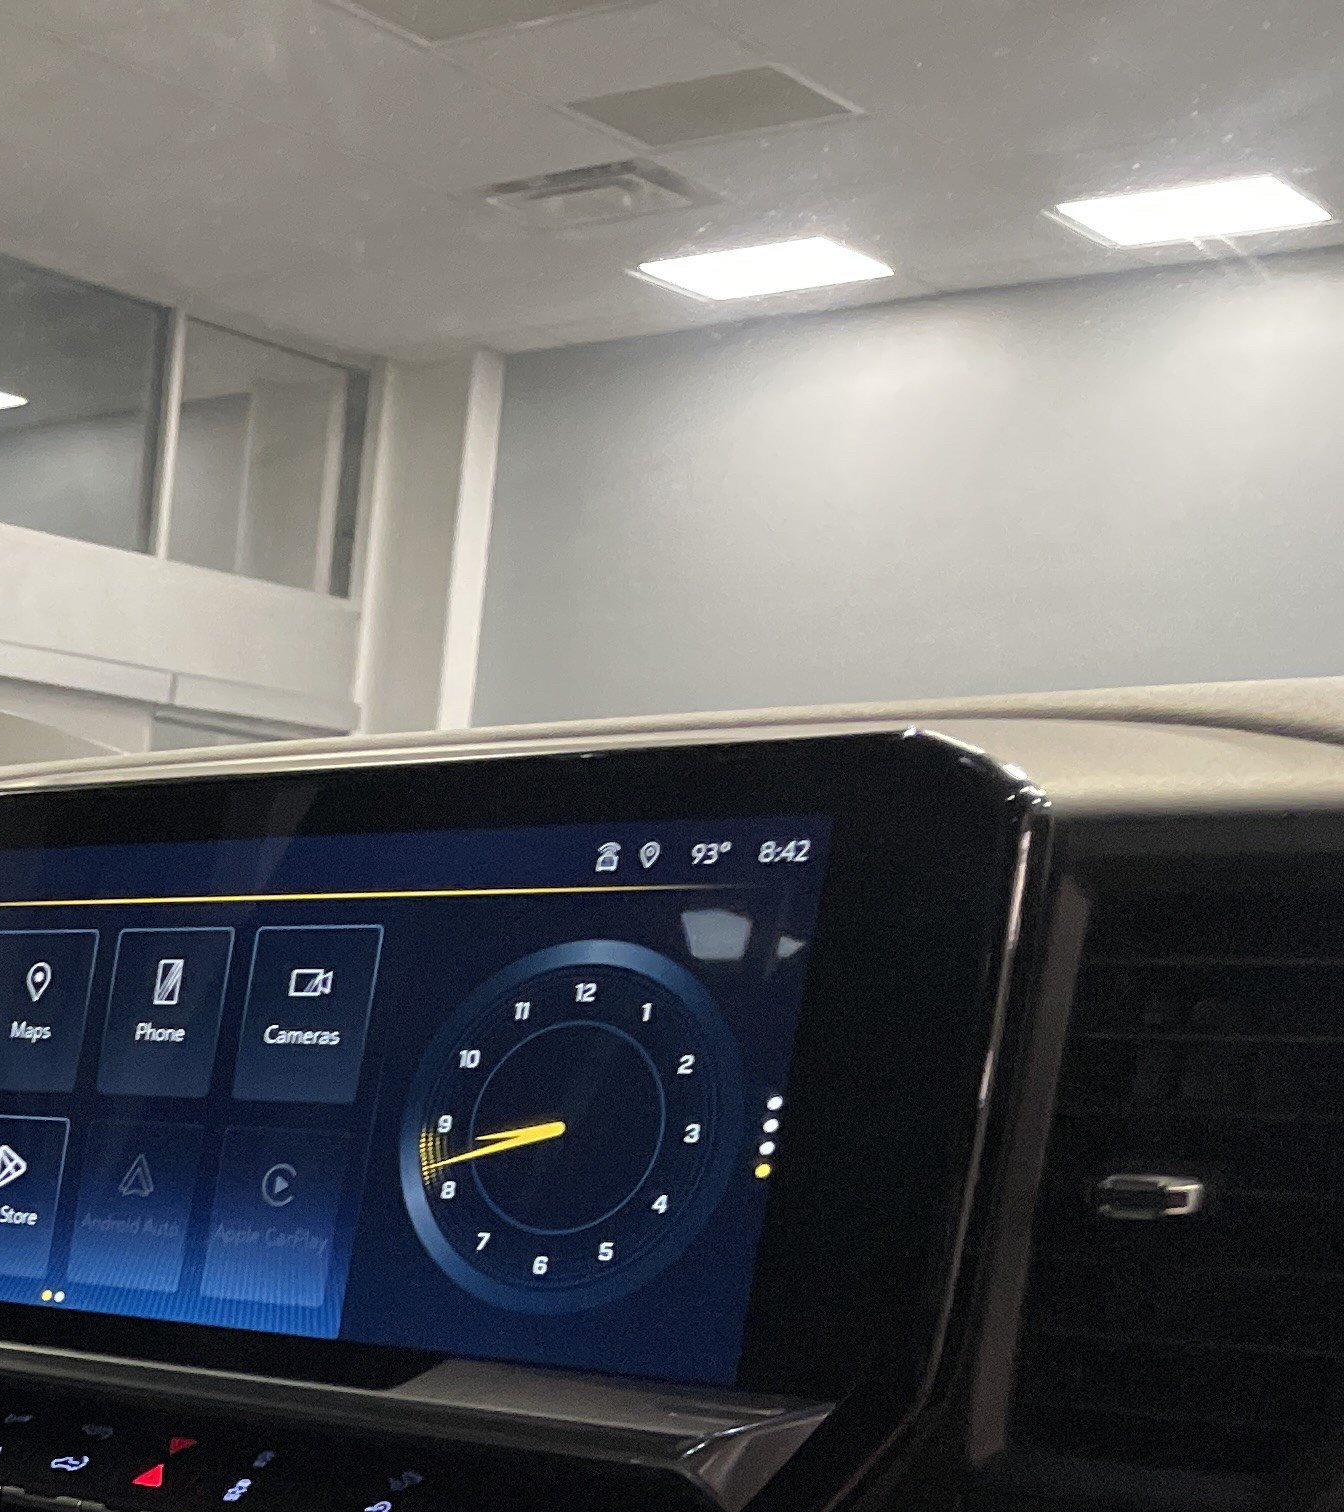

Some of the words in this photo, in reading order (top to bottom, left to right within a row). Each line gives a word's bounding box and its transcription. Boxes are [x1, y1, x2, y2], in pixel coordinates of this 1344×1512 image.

[691, 840, 732, 864] 93°
[757, 838, 811, 863] 8:42
[575, 982, 597, 1003] 12
[514, 1001, 531, 1021] 11
[641, 1002, 653, 1022] 1
[9, 1020, 52, 1043] Maps
[134, 1022, 186, 1042] Phone
[263, 1024, 341, 1046] Cameras
[459, 1049, 481, 1069] 10
[677, 1054, 695, 1075] 2
[437, 1114, 453, 1133] 9
[683, 1123, 701, 1144] 3
[439, 1180, 457, 1200] 8
[651, 1194, 669, 1215] 4
[476, 1232, 491, 1251] 7
[597, 1242, 614, 1261] 5
[532, 1255, 549, 1275] 6
